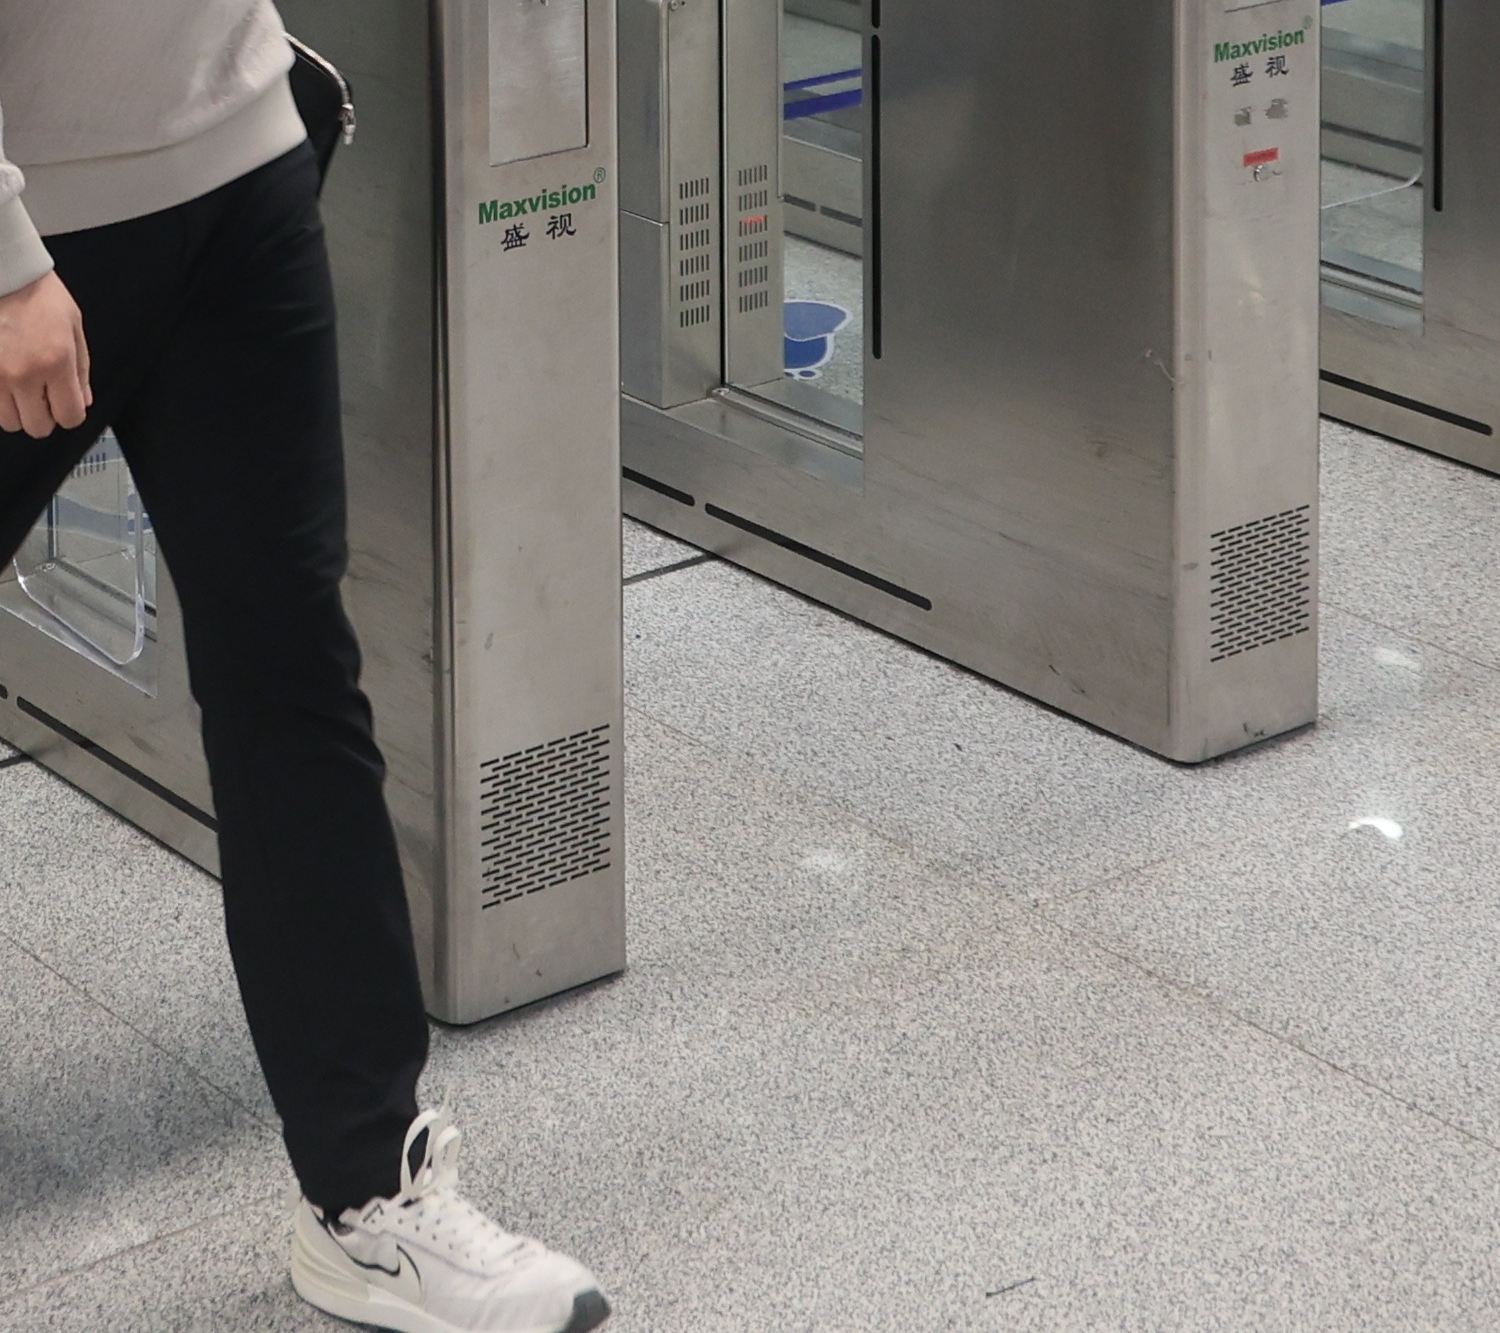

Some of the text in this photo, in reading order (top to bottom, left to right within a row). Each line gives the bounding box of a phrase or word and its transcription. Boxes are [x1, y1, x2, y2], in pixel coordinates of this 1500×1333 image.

[1214, 29, 1305, 63] Maxvision
[1230, 55, 1289, 87] 盛视
[478, 183, 596, 225] Maxvision
[500, 213, 577, 252] 盛视
